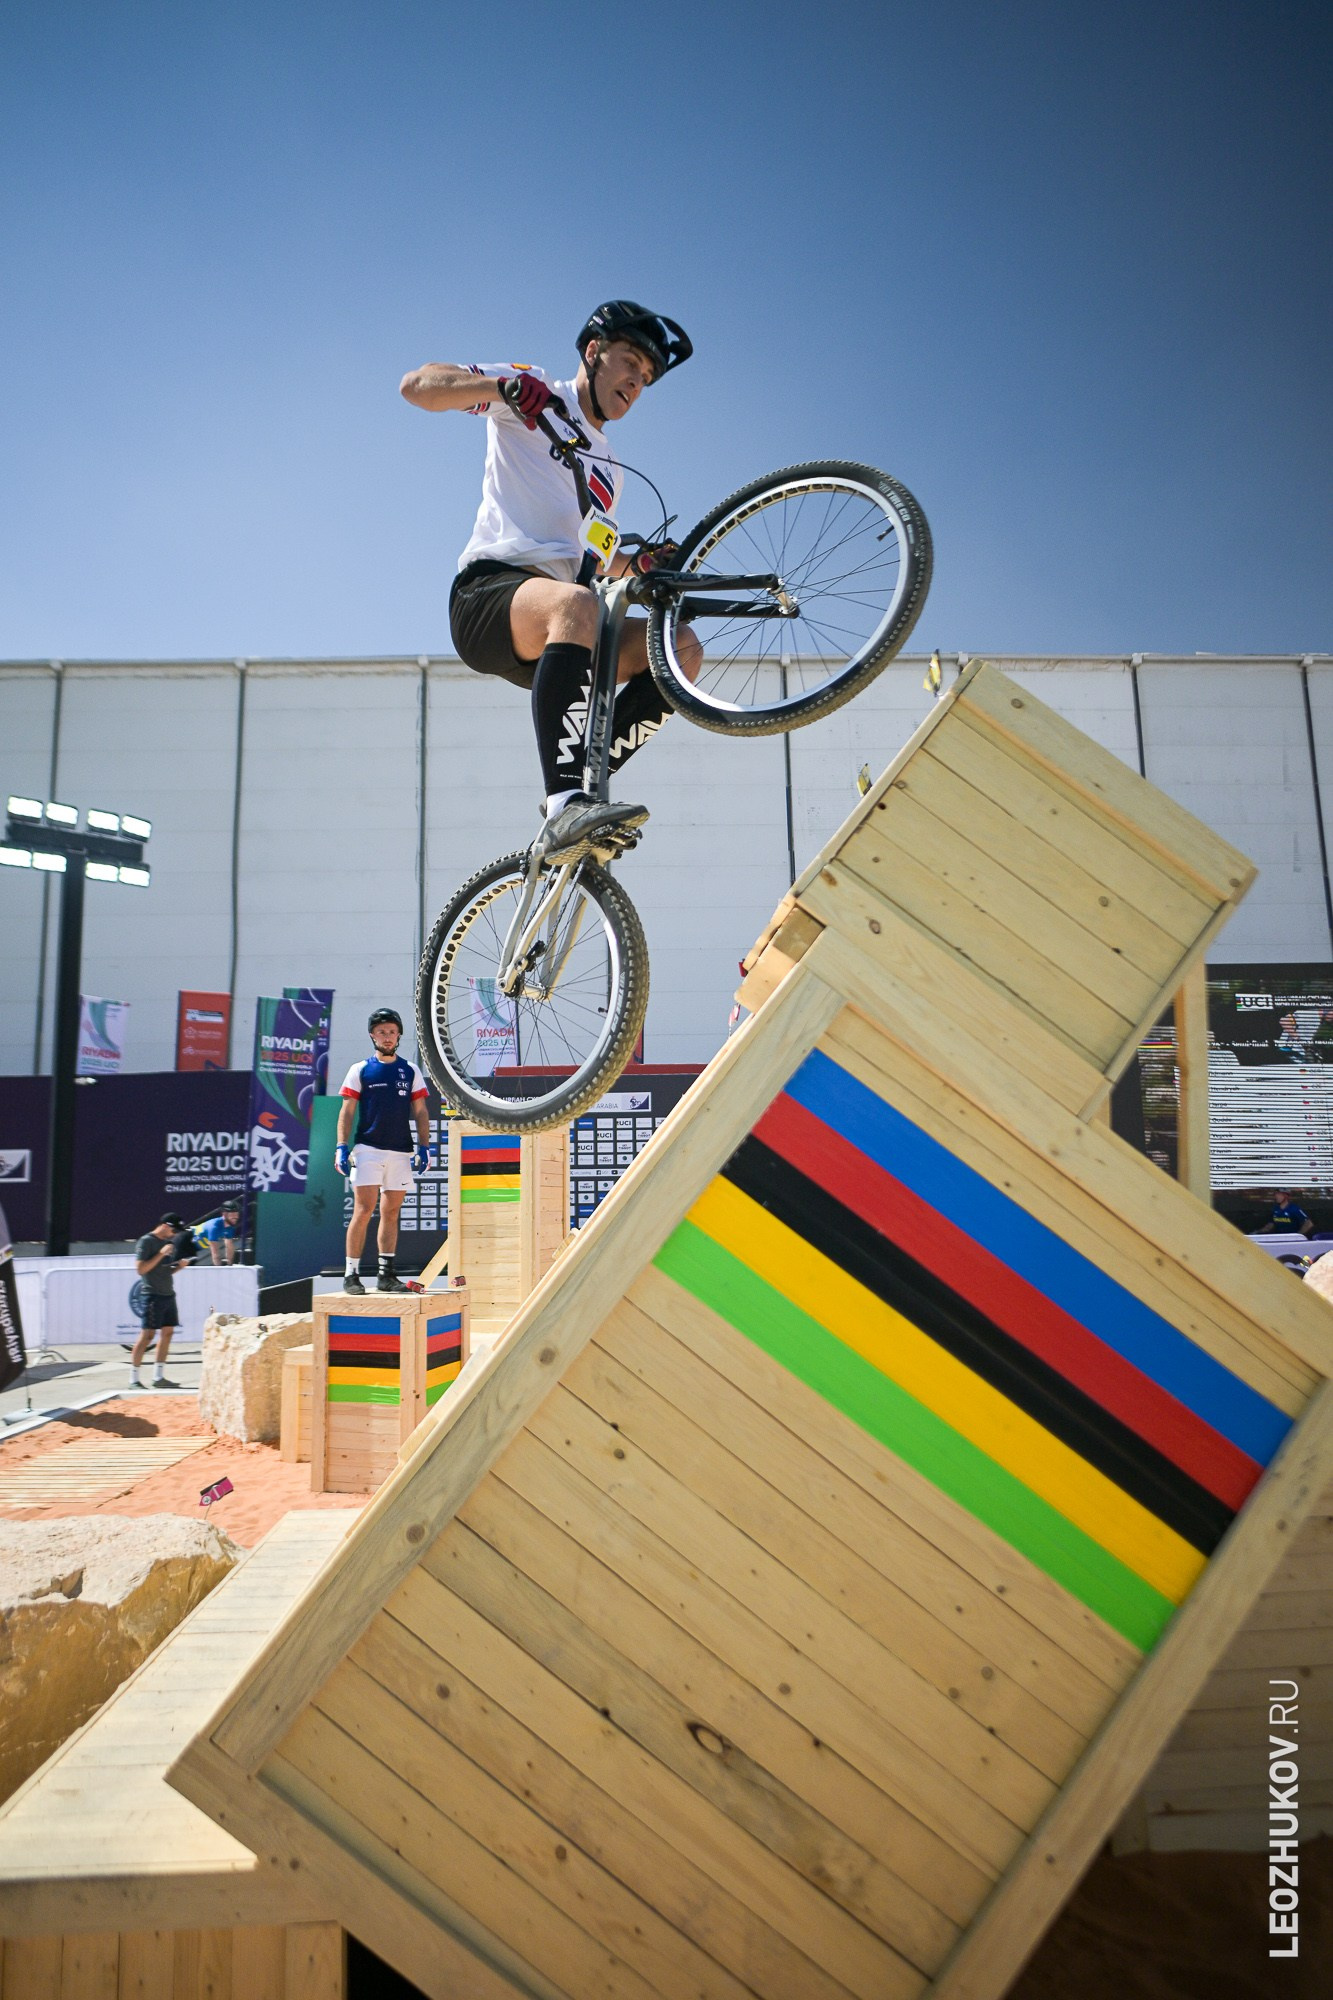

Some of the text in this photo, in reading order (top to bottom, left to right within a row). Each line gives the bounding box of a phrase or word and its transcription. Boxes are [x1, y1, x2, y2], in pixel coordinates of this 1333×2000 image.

[602, 533, 613, 550] 5
[653, 630, 672, 678] NATIONAL
[261, 1035, 314, 1052] RIYADH
[167, 1131, 249, 1152] RIYADH
[166, 1156, 213, 1172] 2025
[191, 1174, 222, 1182] CYCLING
